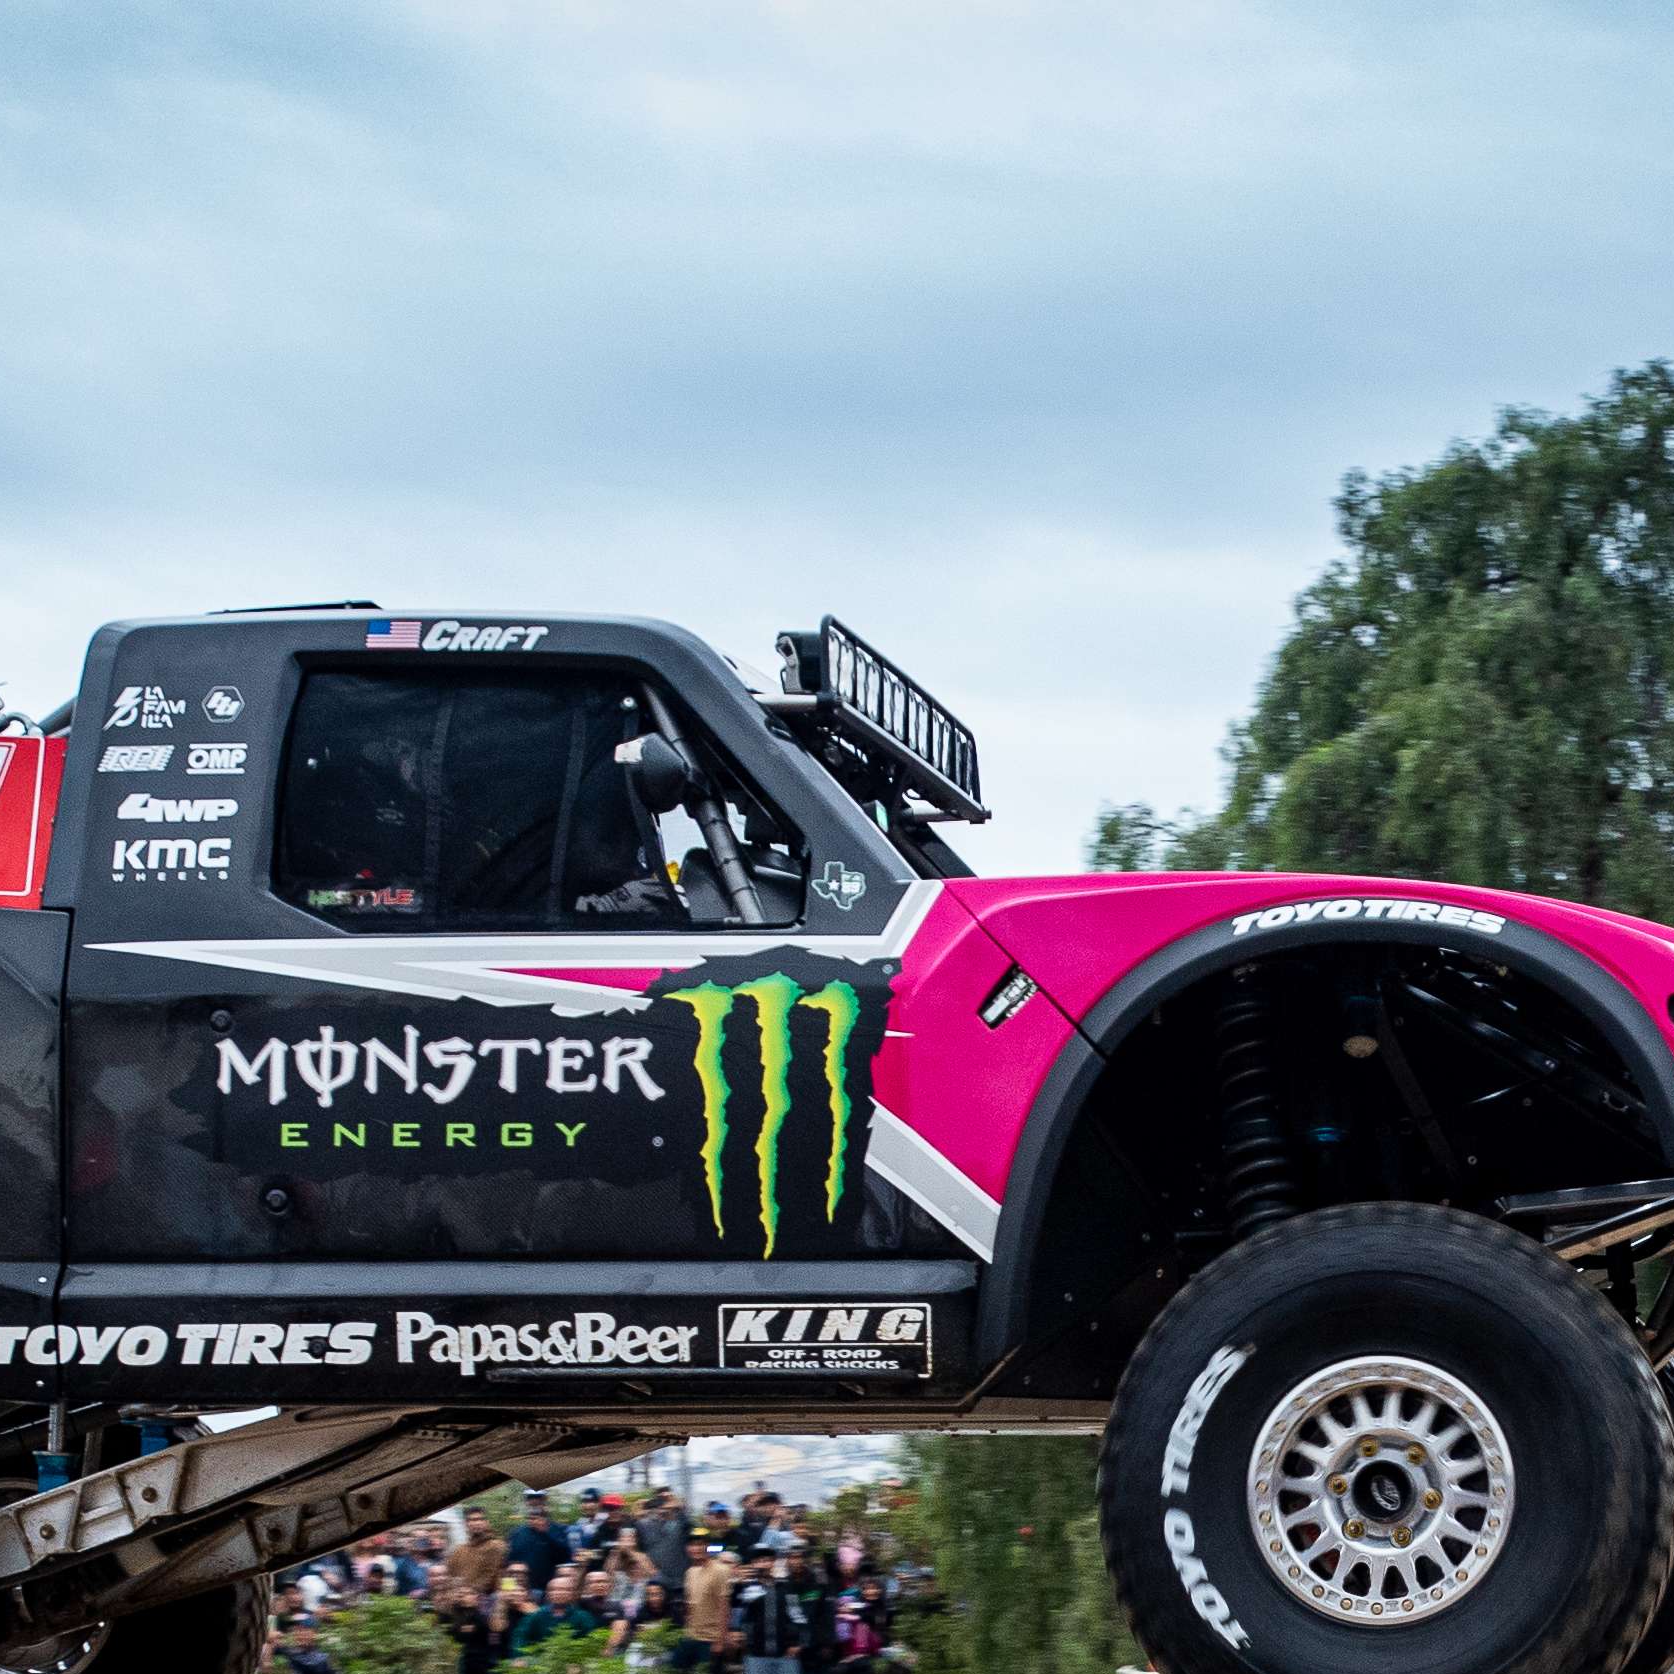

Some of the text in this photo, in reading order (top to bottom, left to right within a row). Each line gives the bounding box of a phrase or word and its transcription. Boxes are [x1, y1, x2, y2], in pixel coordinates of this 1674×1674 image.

[422, 620, 549, 651] CRAFT
[187, 750, 247, 769] OMP
[117, 793, 239, 823] 4WP
[112, 838, 232, 870] KMC
[111, 871, 229, 882] WHEELS
[214, 1024, 666, 1108] MONSTER
[280, 1122, 587, 1147] ENERGY
[726, 1308, 925, 1342] KING
[175, 1322, 378, 1366] TIRES
[822, 1350, 882, 1359] ROAD
[1163, 1507, 1253, 1650] TOYO
